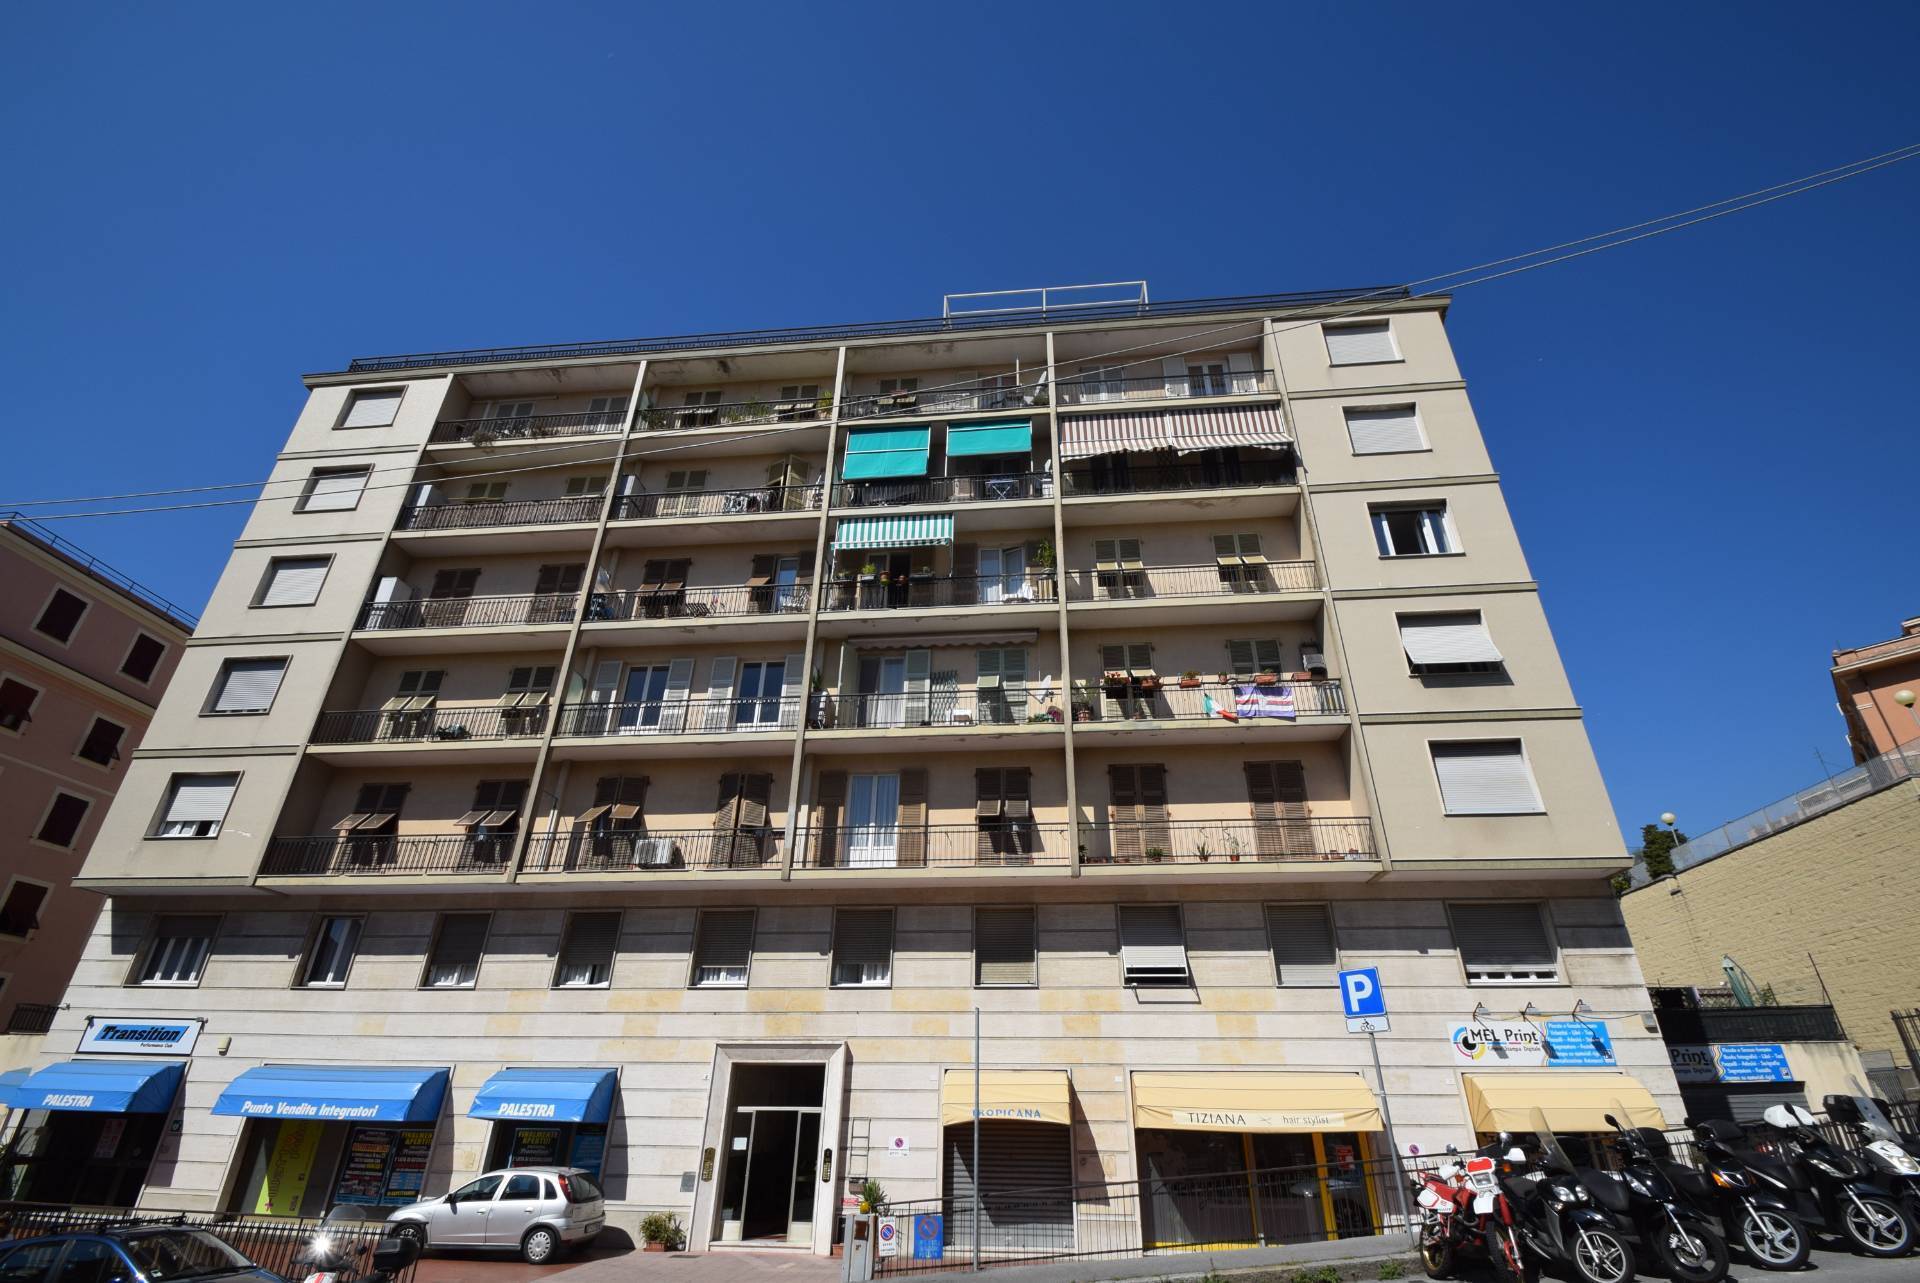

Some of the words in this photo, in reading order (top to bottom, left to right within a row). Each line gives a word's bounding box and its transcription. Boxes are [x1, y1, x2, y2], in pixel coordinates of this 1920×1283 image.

[1346, 974, 1372, 1012] P
[101, 1026, 180, 1042] Transition
[1471, 1029, 1501, 1042] MEL
[1505, 1029, 1539, 1044] Print
[1671, 1048, 1708, 1065] Print
[41, 1094, 94, 1107] PALESTRA
[240, 1101, 273, 1113] Punto
[276, 1102, 318, 1115] Vendita
[318, 1103, 380, 1119] Integratori
[498, 1103, 555, 1117] PALESTRA
[973, 1109, 1041, 1118] ROPICANA
[1187, 1112, 1247, 1125] TIZIANA
[1282, 1115, 1299, 1125] hair
[1303, 1115, 1329, 1126] stylist
